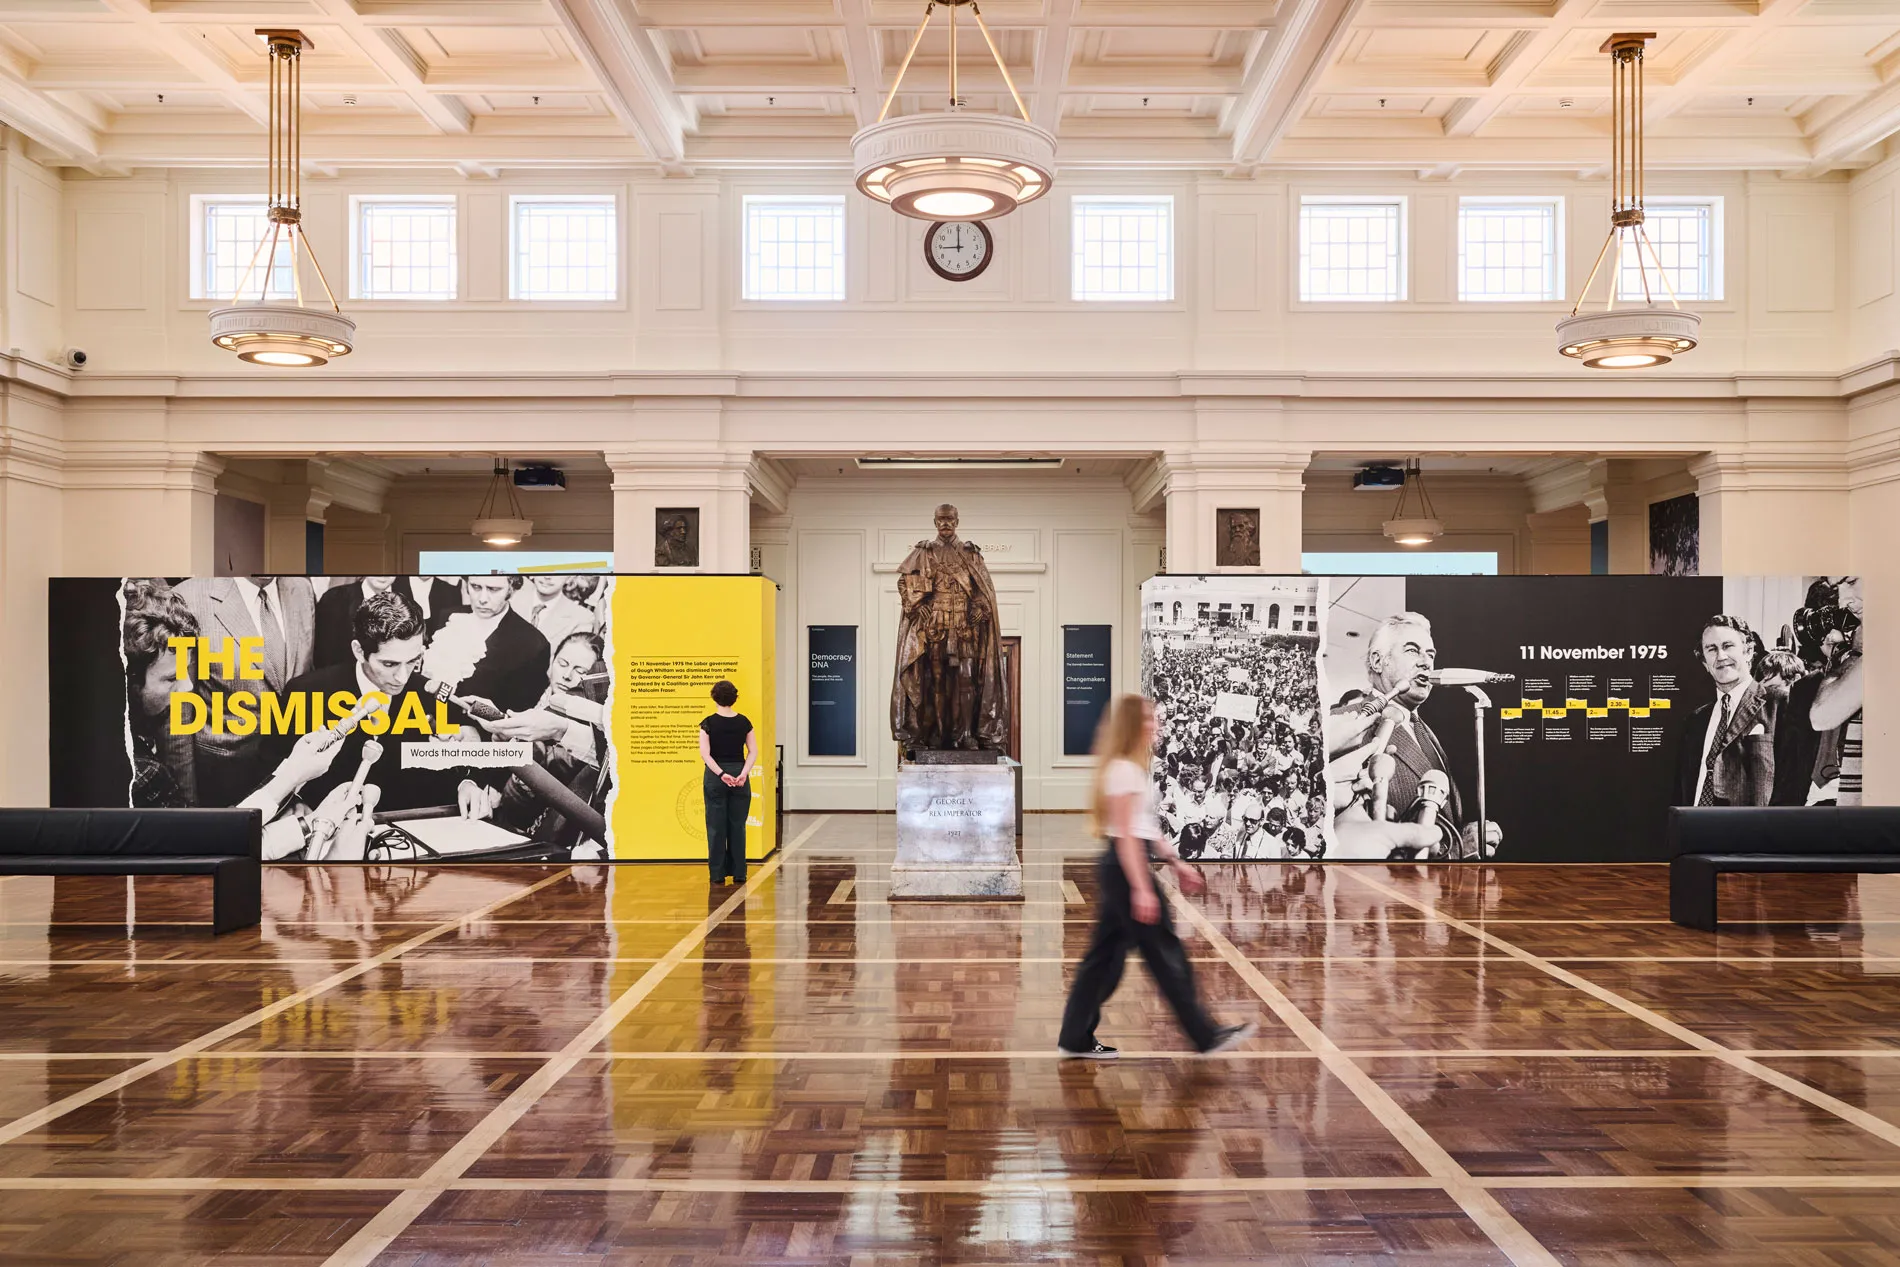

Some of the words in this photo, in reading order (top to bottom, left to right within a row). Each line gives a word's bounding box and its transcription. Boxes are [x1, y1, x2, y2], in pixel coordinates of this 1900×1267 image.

[168, 636, 264, 680] THE
[812, 654, 852, 662] Democracy
[1520, 645, 1534, 659] 11
[1540, 645, 1624, 659] November
[1630, 645, 1668, 659] 1975
[436, 683, 451, 702] 2UE
[170, 691, 460, 736] DISMISSAL
[410, 748, 439, 758] Words
[441, 748, 459, 758] that
[462, 748, 490, 758] made
[492, 748, 524, 758] history
